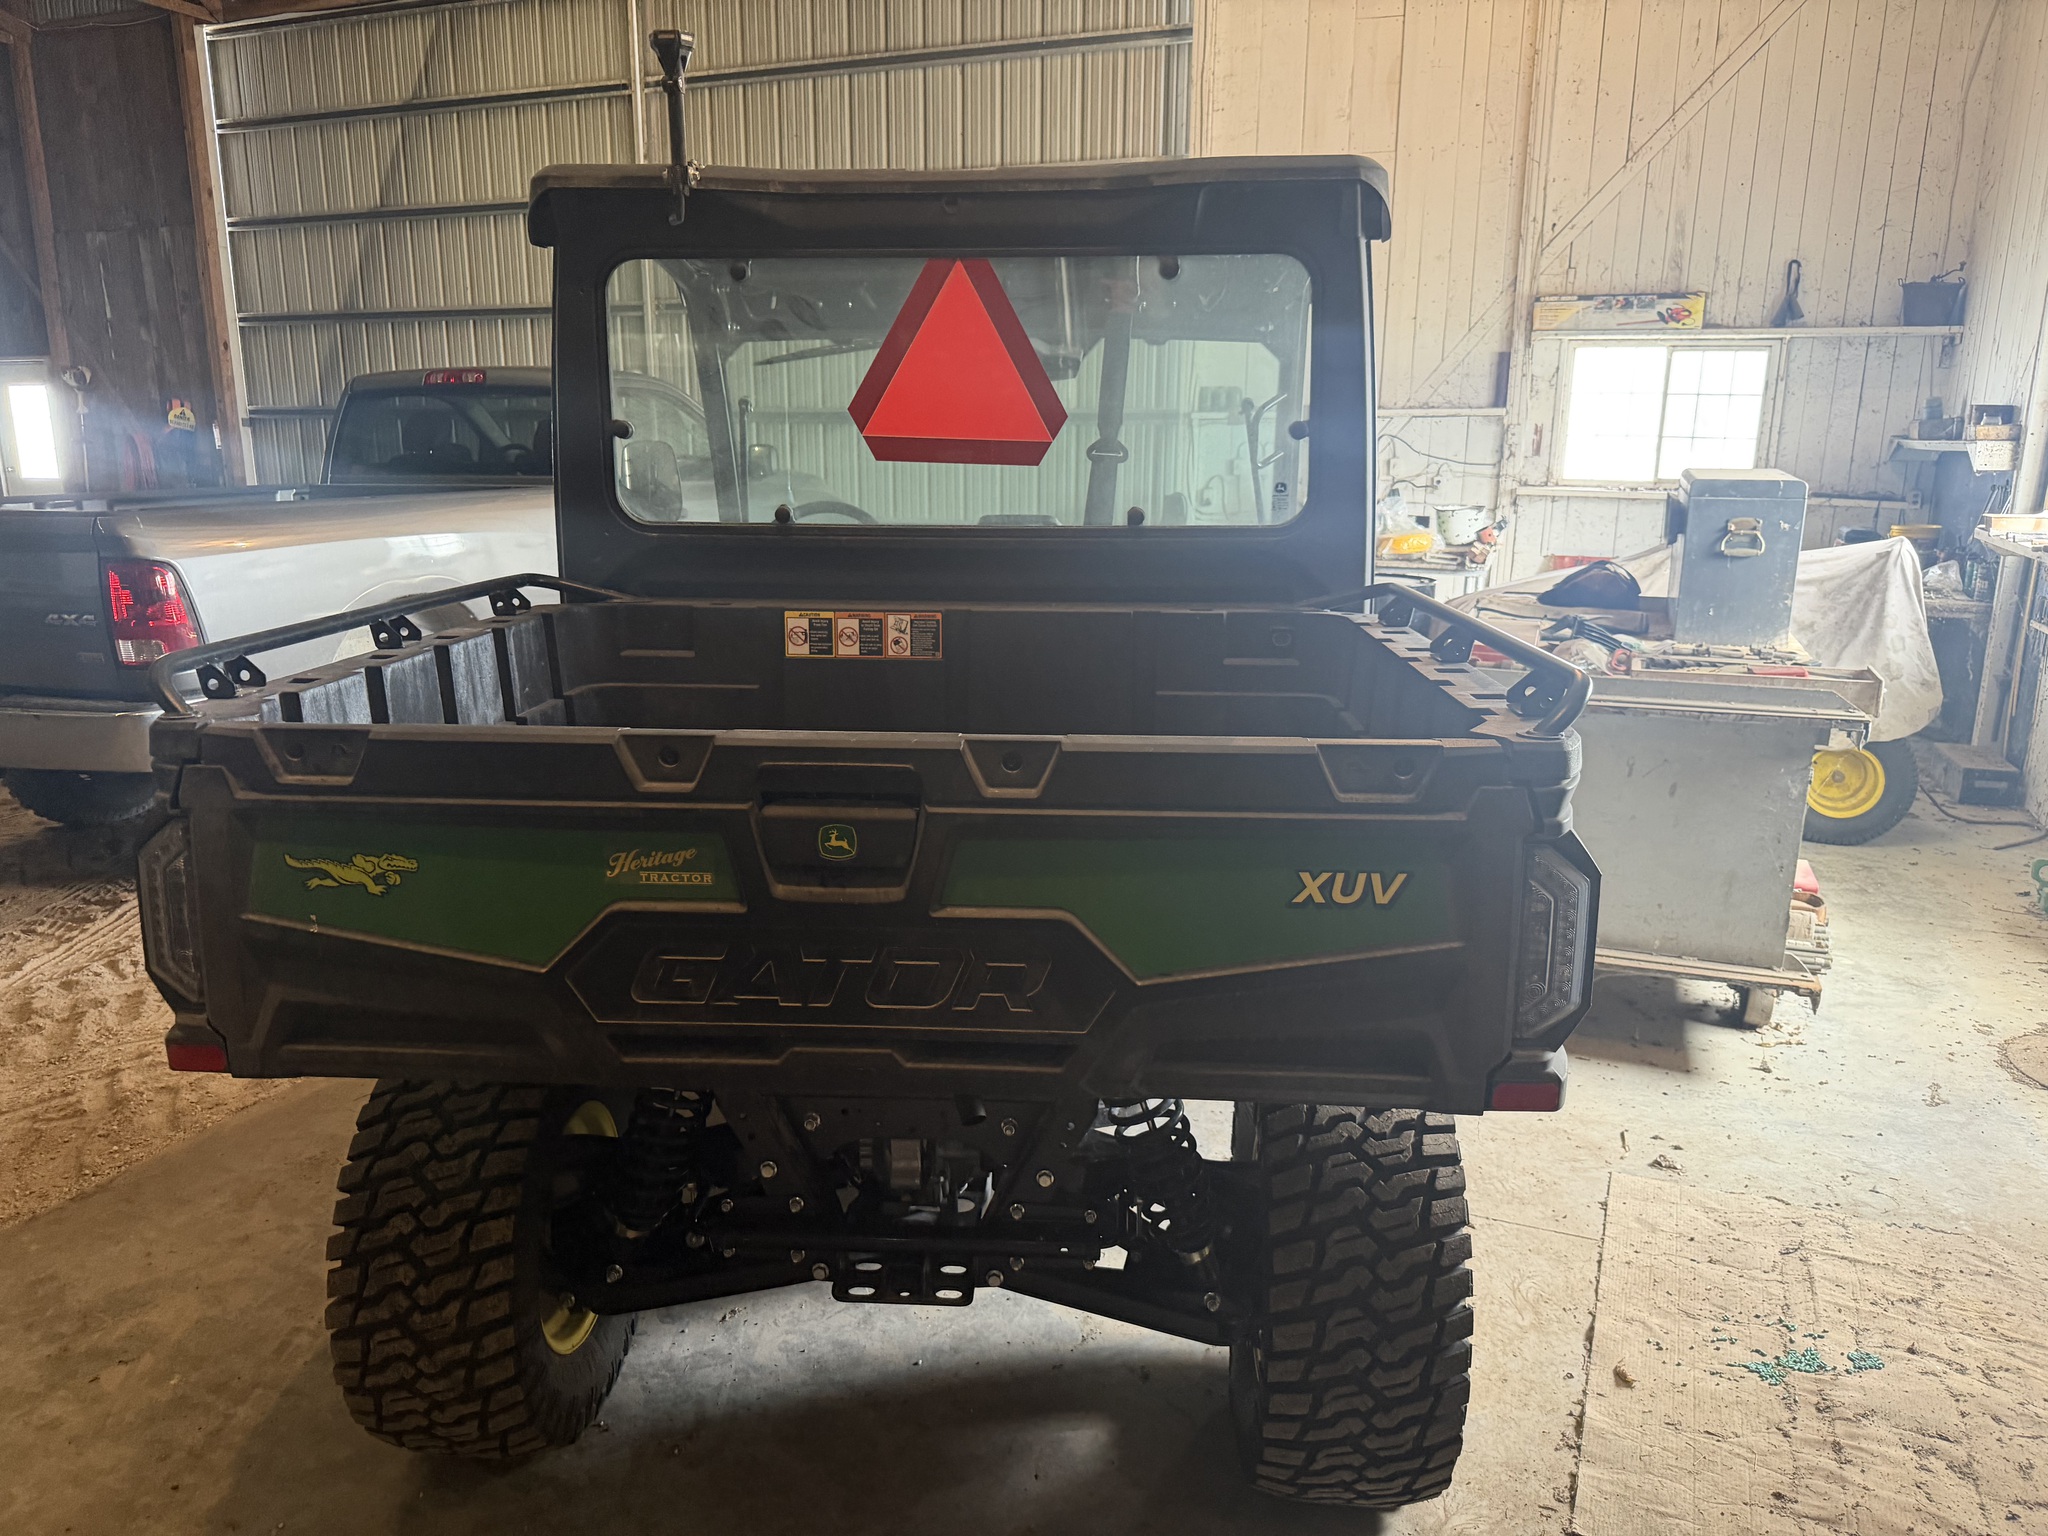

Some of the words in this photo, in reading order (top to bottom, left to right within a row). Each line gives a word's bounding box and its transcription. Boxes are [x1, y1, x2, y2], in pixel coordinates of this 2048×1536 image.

[606, 847, 698, 878] Heritage
[639, 873, 713, 883] TRACTOR
[1292, 872, 1408, 904] XUV
[629, 947, 1053, 1013] GATOR
